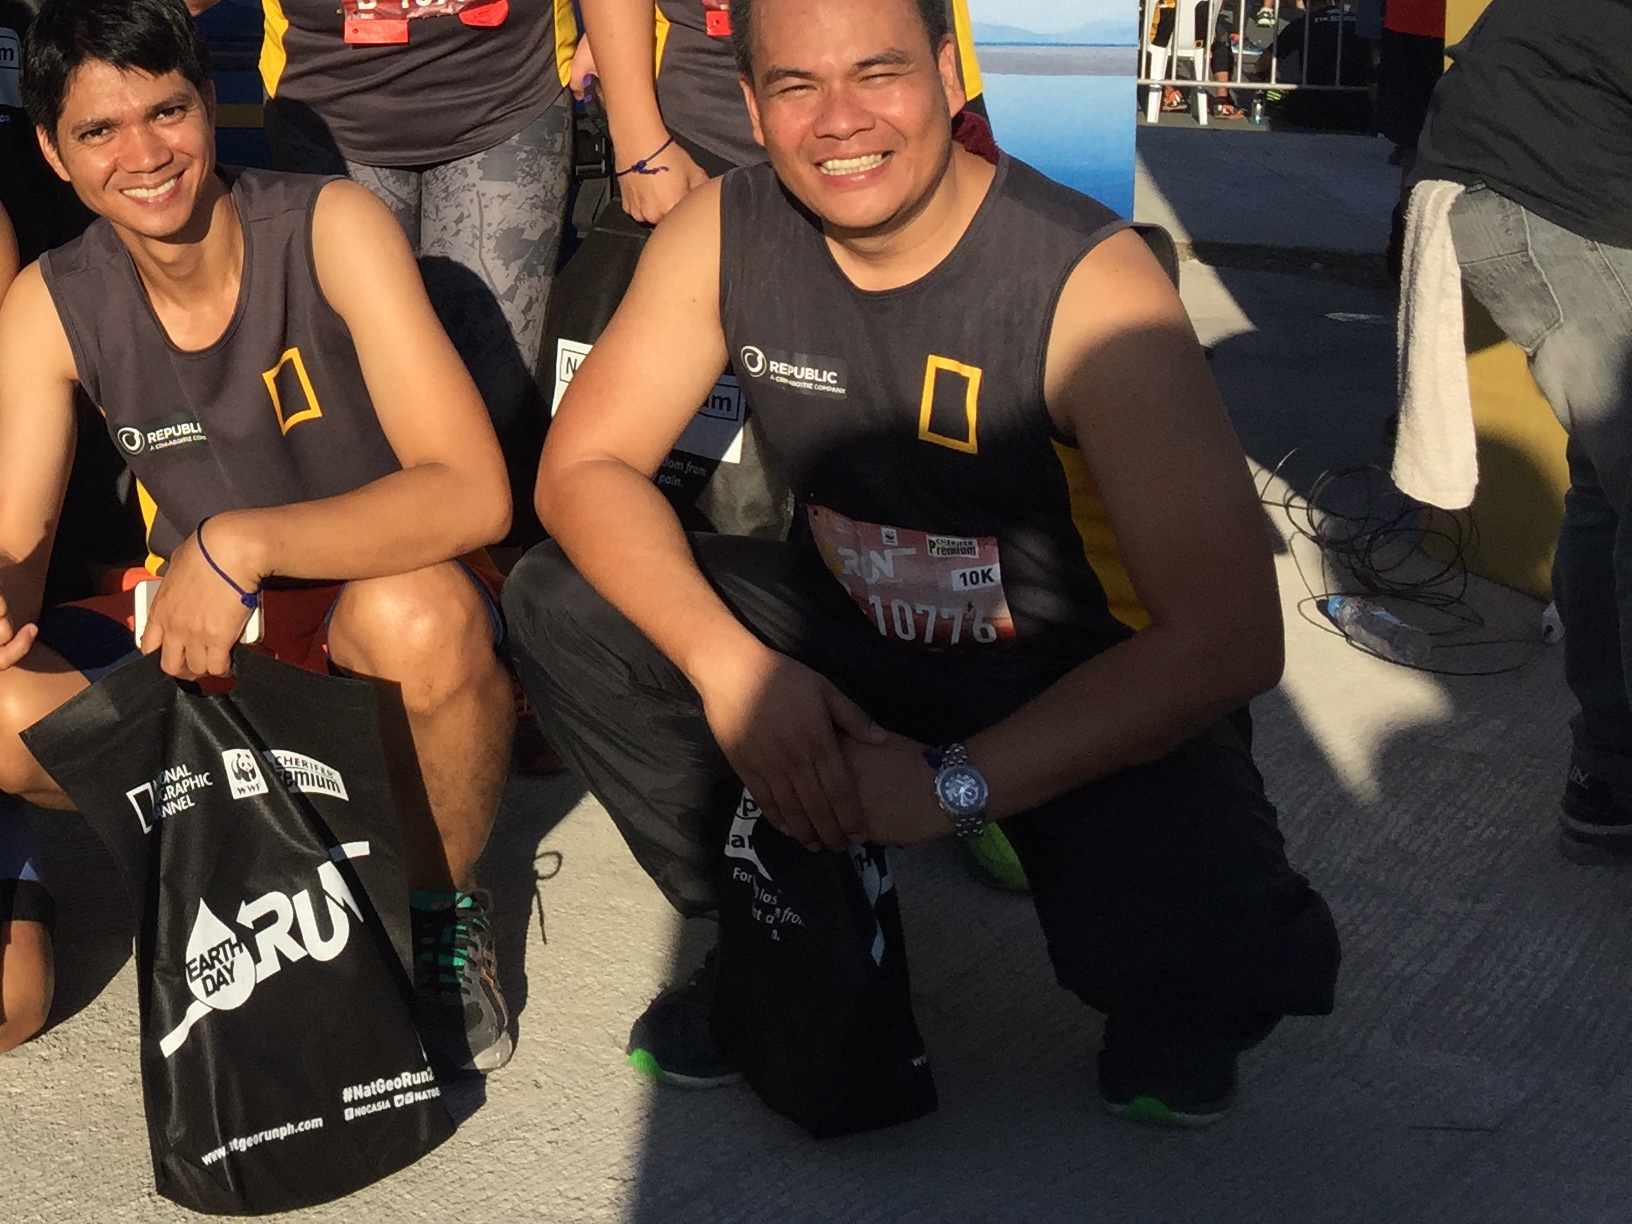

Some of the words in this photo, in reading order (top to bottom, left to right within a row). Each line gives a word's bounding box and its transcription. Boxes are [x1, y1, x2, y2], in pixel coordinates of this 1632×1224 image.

[769, 360, 838, 384] REPUBLIC
[147, 422, 202, 444] REPUBLI
[658, 475, 684, 488] pain.
[927, 539, 977, 556] Premium
[959, 567, 995, 587] 10K
[848, 590, 998, 645] 10776
[236, 784, 262, 795] WWF
[277, 768, 342, 794] emium
[185, 936, 244, 984] EARTH
[201, 964, 238, 999] DAY
